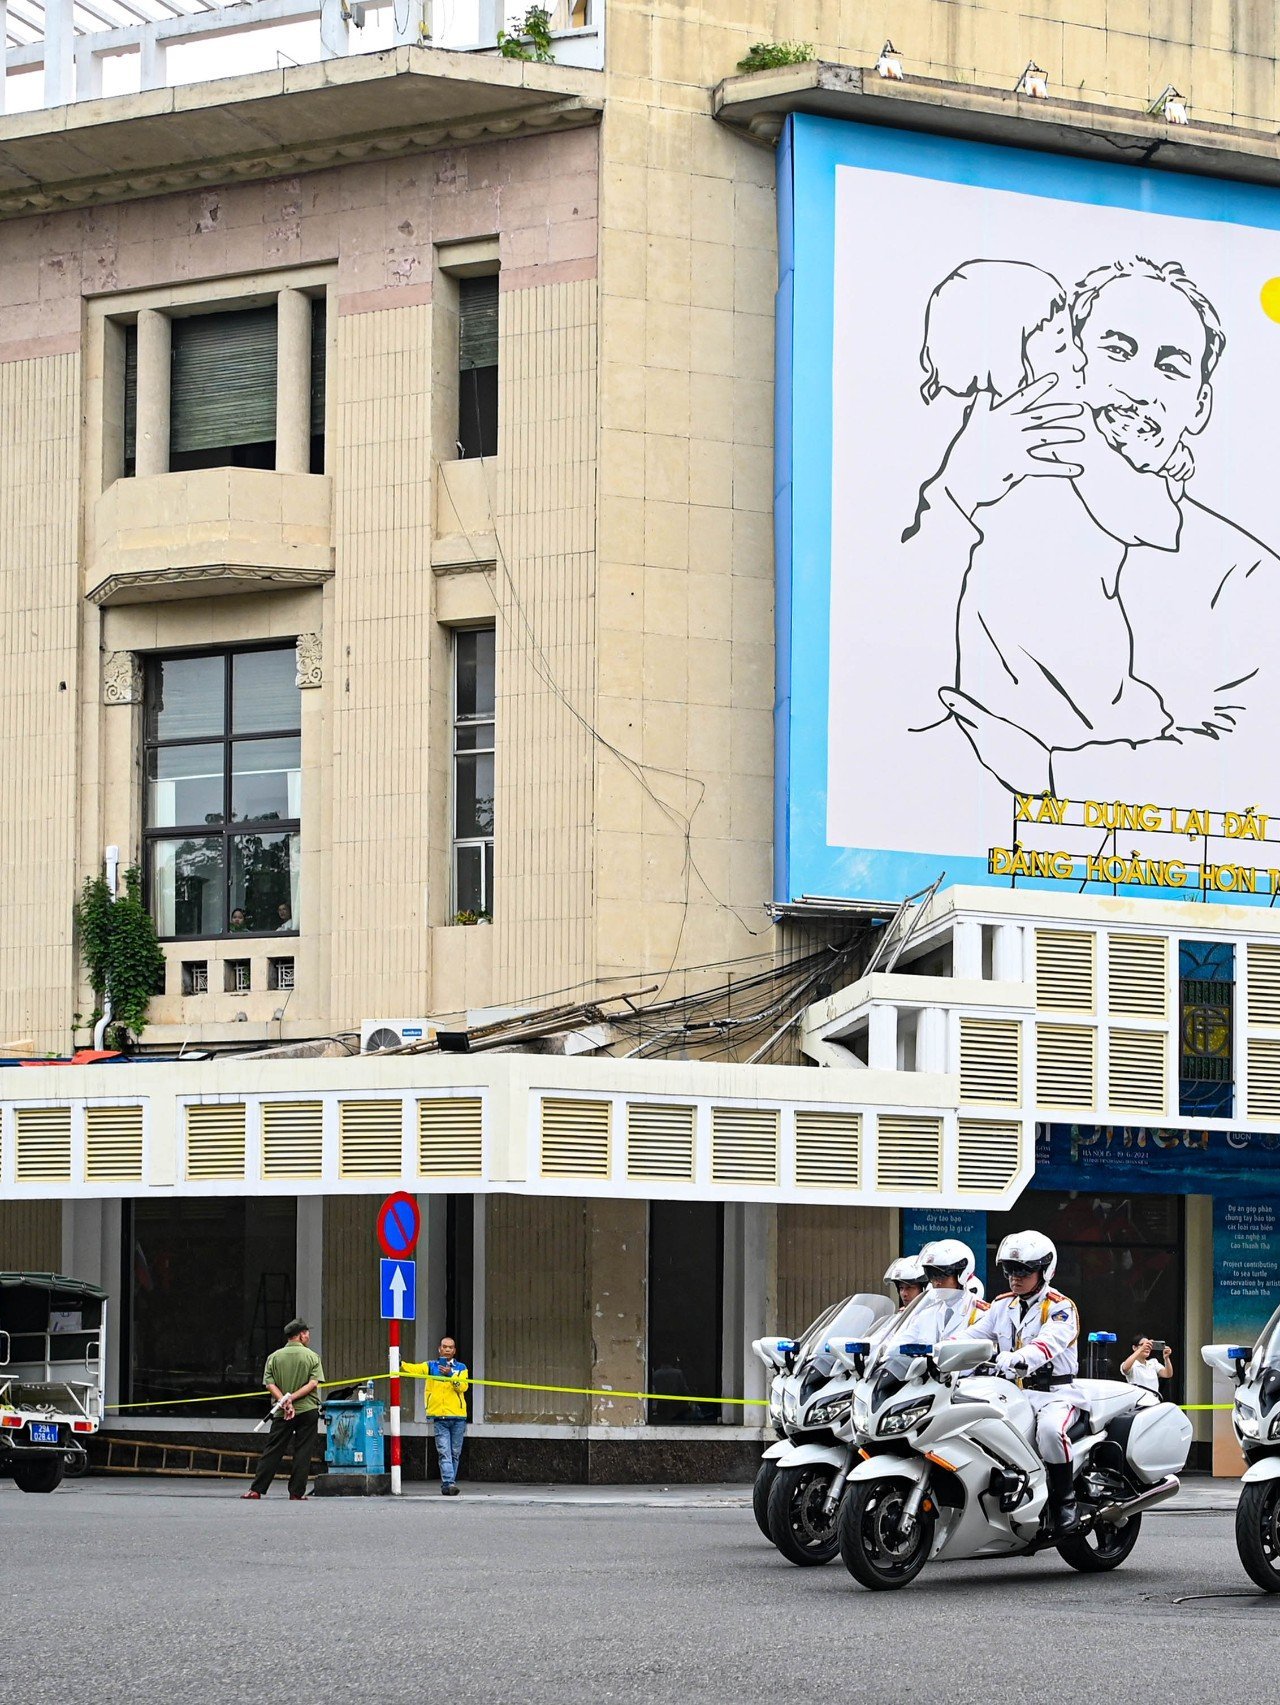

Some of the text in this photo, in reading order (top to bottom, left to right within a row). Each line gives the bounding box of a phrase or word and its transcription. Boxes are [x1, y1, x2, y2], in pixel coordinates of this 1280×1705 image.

[1015, 790, 1069, 824] XÂY
[1084, 800, 1162, 835] DỰNG
[1172, 807, 1210, 841] LẠI
[1221, 804, 1269, 841] ĐẤT
[989, 840, 1073, 879] ĐÀNG
[1087, 850, 1187, 887] HOÀNG
[1200, 863, 1256, 893] HƠN
[1244, 1261, 1277, 1269] contributing
